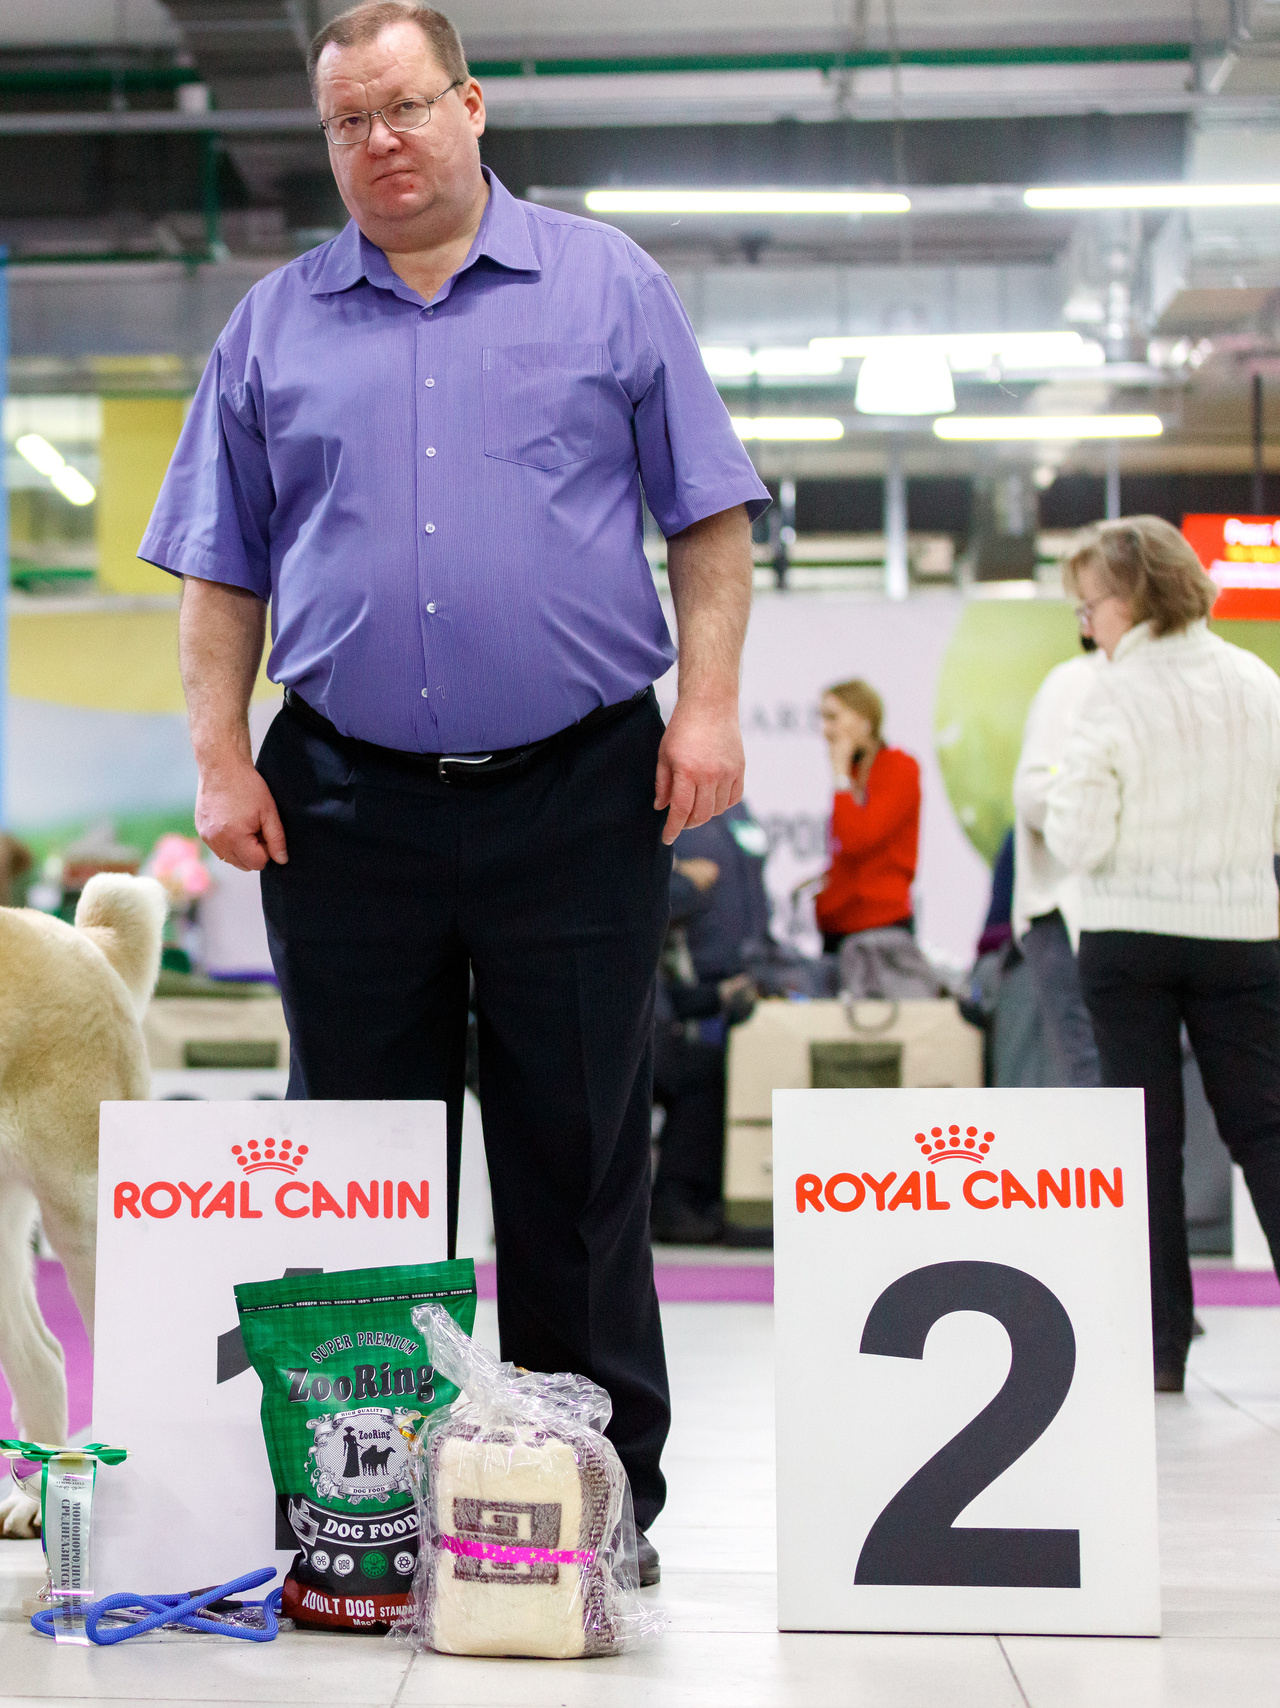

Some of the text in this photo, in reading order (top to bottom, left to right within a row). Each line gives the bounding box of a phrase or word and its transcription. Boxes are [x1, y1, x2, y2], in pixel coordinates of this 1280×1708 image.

[113, 1180, 430, 1219] ROYAL CANIN
[795, 1166, 1124, 1213] ROYAL CANIN
[310, 1331, 420, 1364] SUPER PREMIUM
[288, 1362, 436, 1404] ZooRing
[358, 1429, 391, 1441] ZooRing
[853, 1260, 1081, 1589] 2
[368, 1486, 386, 1494] FOOD
[322, 1513, 420, 1539] DOG FOOD
[301, 1590, 341, 1615] ADULT
[345, 1598, 376, 1618] DOG
